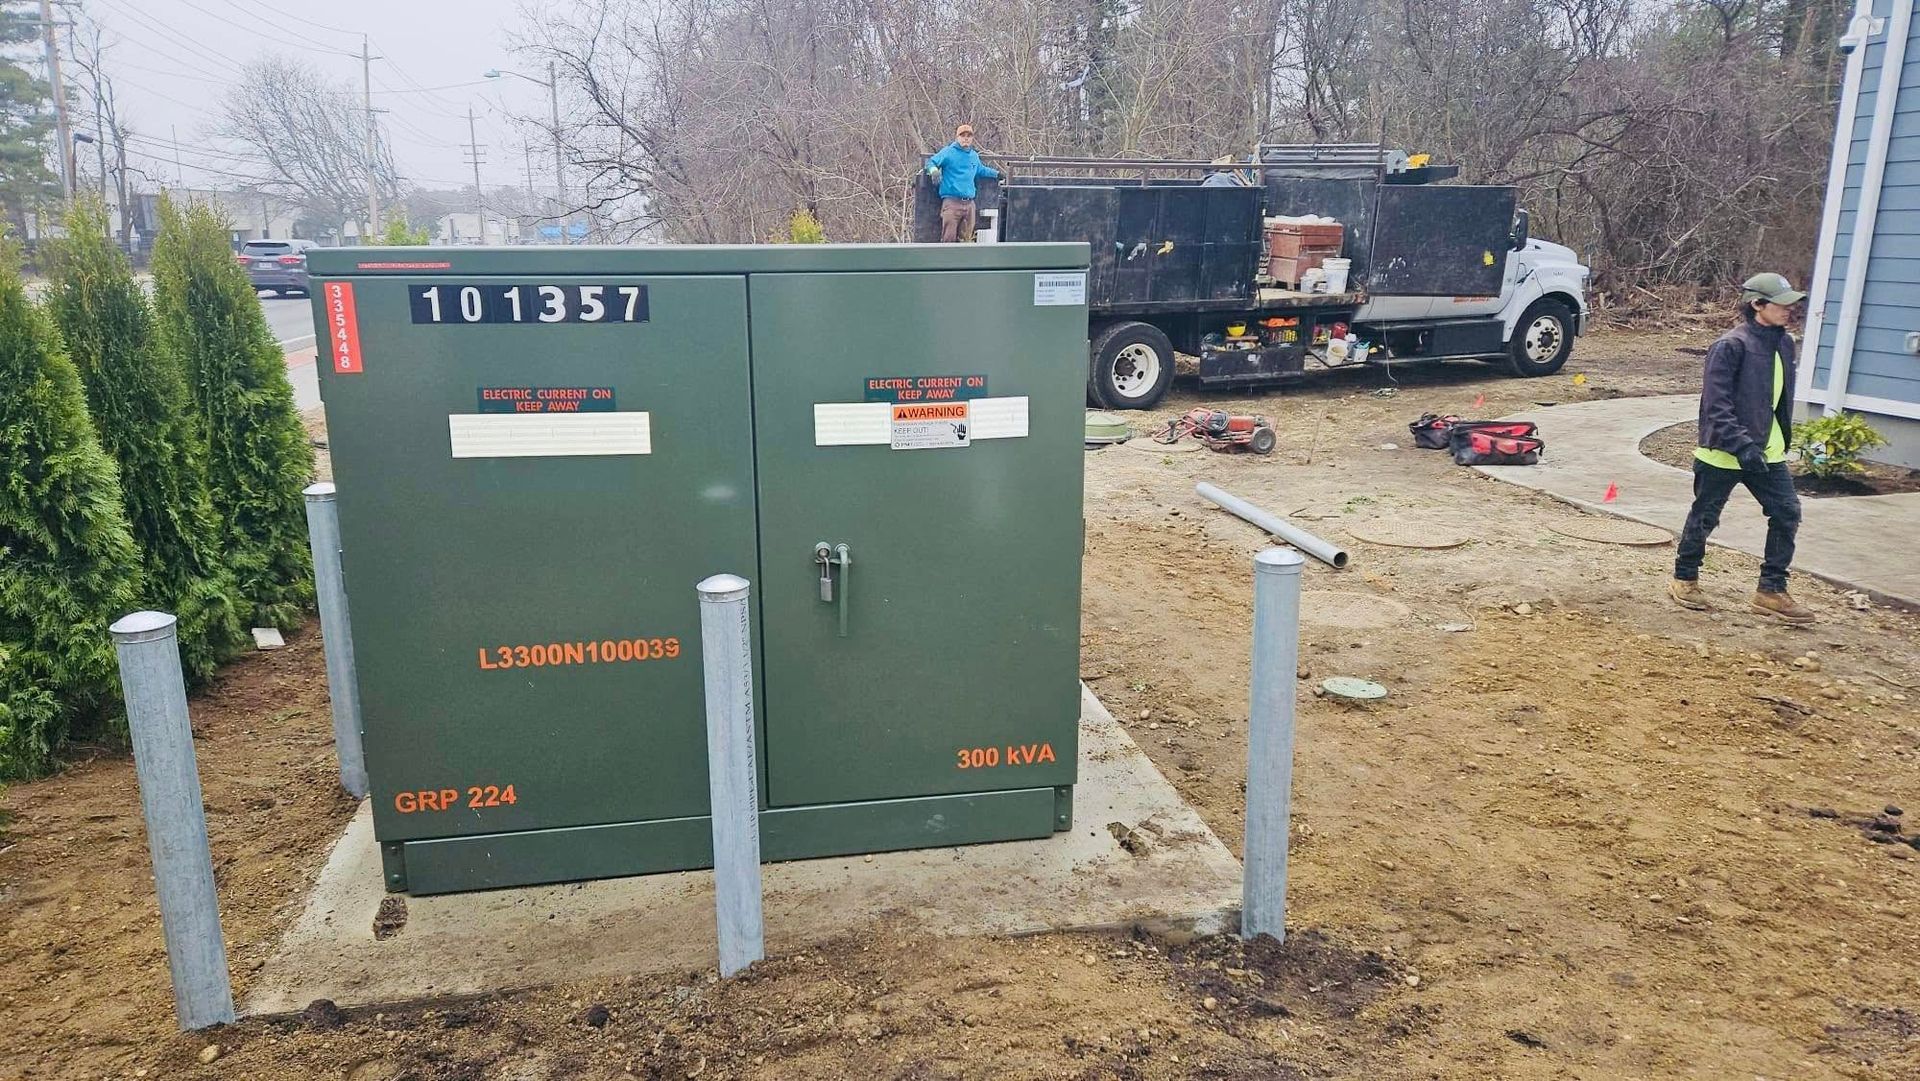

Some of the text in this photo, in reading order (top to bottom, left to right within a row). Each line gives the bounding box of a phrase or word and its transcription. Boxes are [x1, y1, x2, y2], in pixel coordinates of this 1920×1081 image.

[422, 286, 639, 322] 101357
[332, 285, 350, 368] 335448
[868, 377, 984, 390] ELECTRIC CURRENT ON
[483, 389, 611, 400] ELECTRIC CURRENT ON
[898, 389, 955, 400] KEEP AWAY
[516, 401, 580, 411] KEEP AWAY
[908, 406, 964, 418] WARNING
[479, 638, 680, 670] L3300N100039
[957, 743, 1056, 769] 300 kVA
[394, 784, 517, 813] GRP 224
